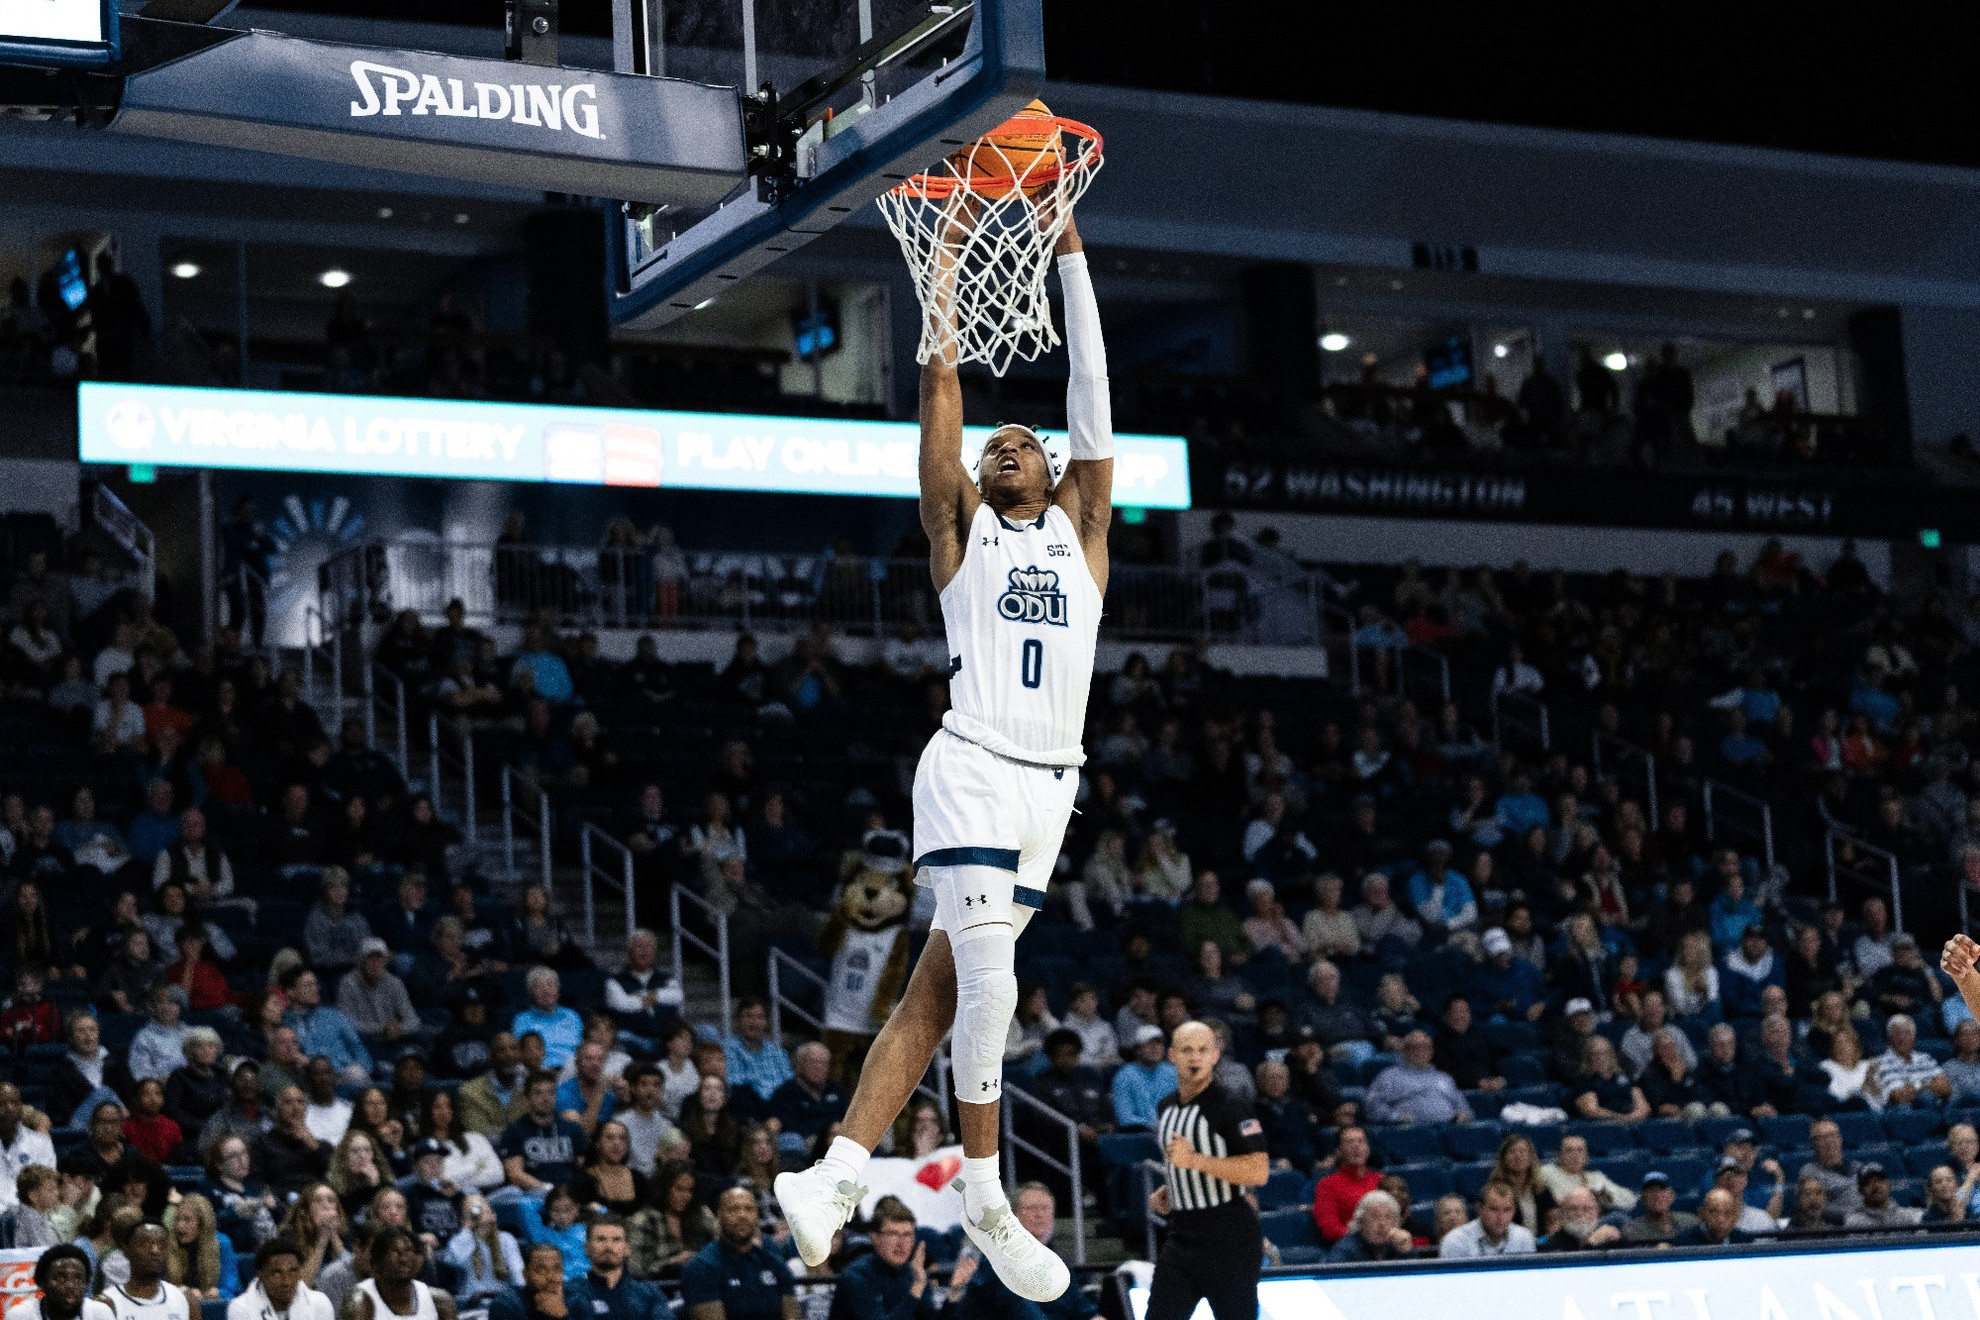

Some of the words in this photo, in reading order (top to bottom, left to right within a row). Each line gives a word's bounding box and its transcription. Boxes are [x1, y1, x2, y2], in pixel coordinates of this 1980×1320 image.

[350, 61, 601, 139] SPALDING
[160, 409, 337, 452] VIRGINIA
[344, 417, 524, 460] LOTTERY
[678, 433, 774, 470] PLAY
[782, 437, 915, 478] ONLINE
[998, 592, 1069, 627] ODU
[1022, 638, 1043, 689] 0
